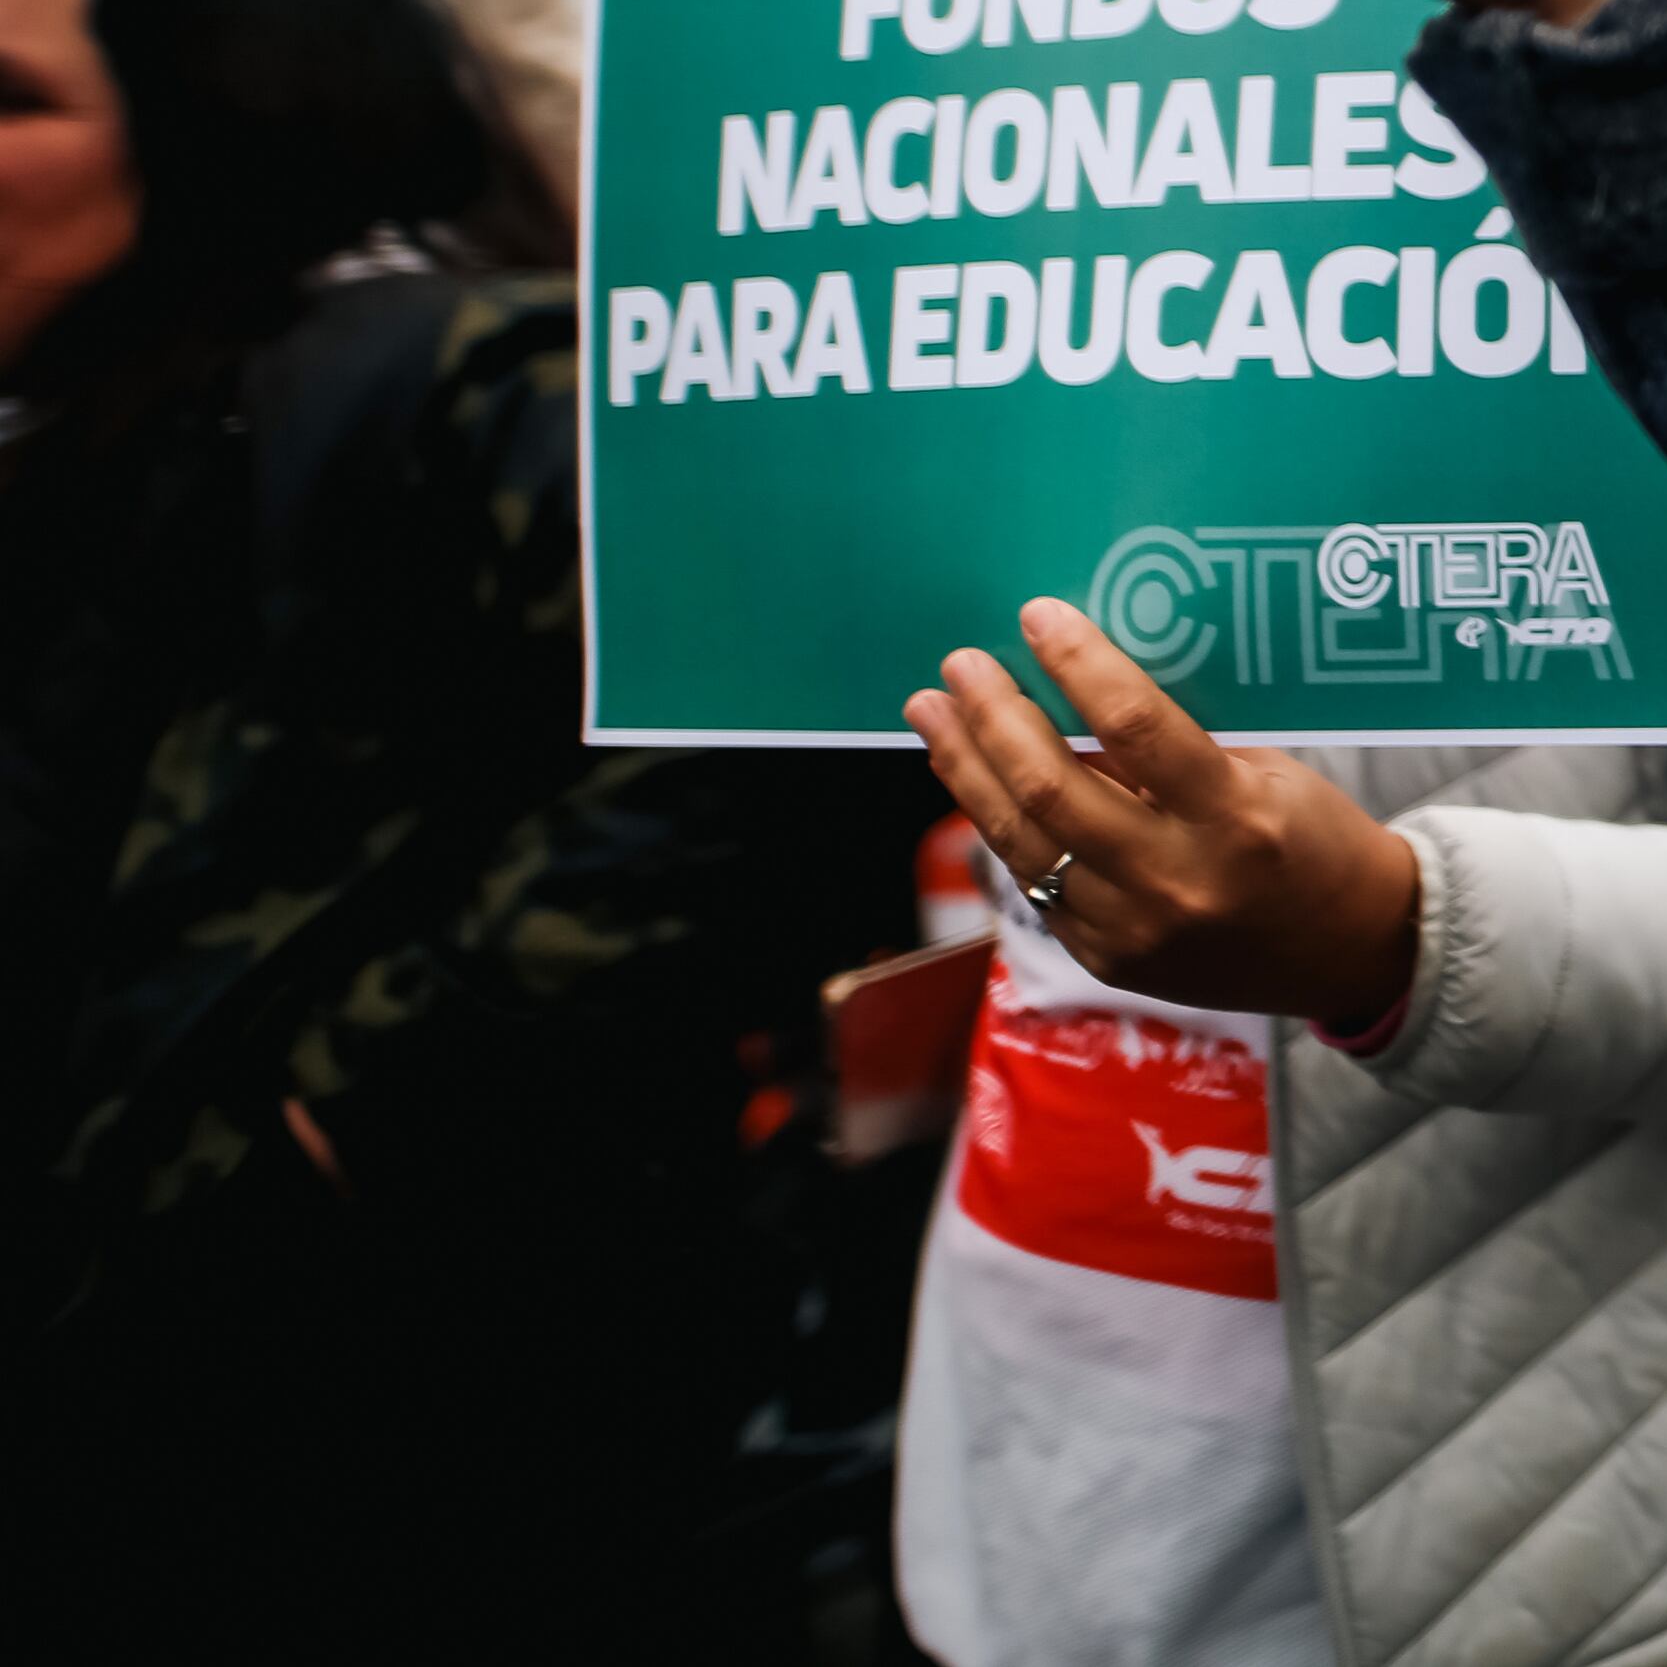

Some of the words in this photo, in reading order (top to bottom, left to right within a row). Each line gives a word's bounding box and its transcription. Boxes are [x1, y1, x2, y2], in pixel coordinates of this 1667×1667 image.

[717, 70, 1488, 235] NACIONALES
[608, 272, 871, 406] PARA
[1317, 521, 1609, 609] CTERA
